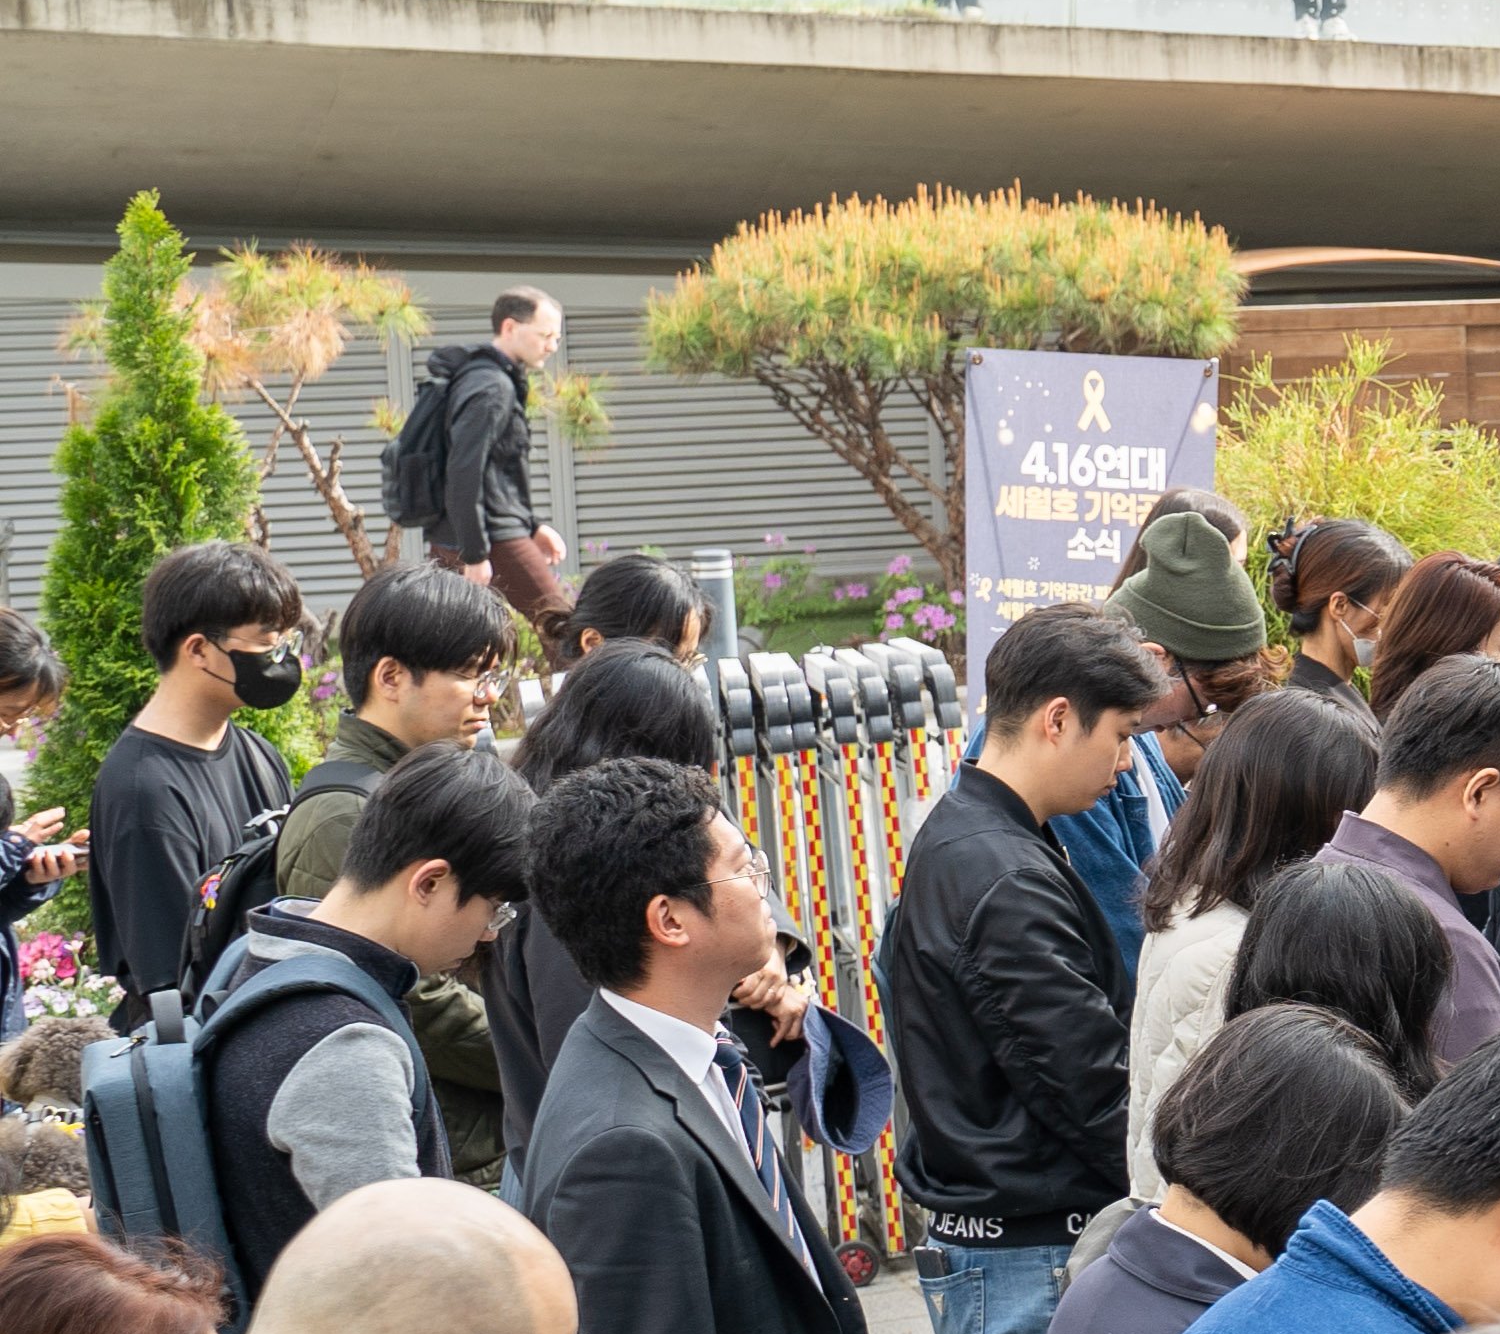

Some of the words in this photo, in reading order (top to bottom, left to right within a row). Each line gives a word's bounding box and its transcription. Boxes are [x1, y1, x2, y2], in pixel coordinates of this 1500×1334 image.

[1020, 440, 1166, 492] 4.16연대
[995, 485, 1080, 522] 세월호
[1066, 527, 1121, 564] 소식
[996, 578, 1038, 599] 세월호
[1040, 581, 1094, 602] 기억공간
[936, 1213, 1003, 1239] JEANS
